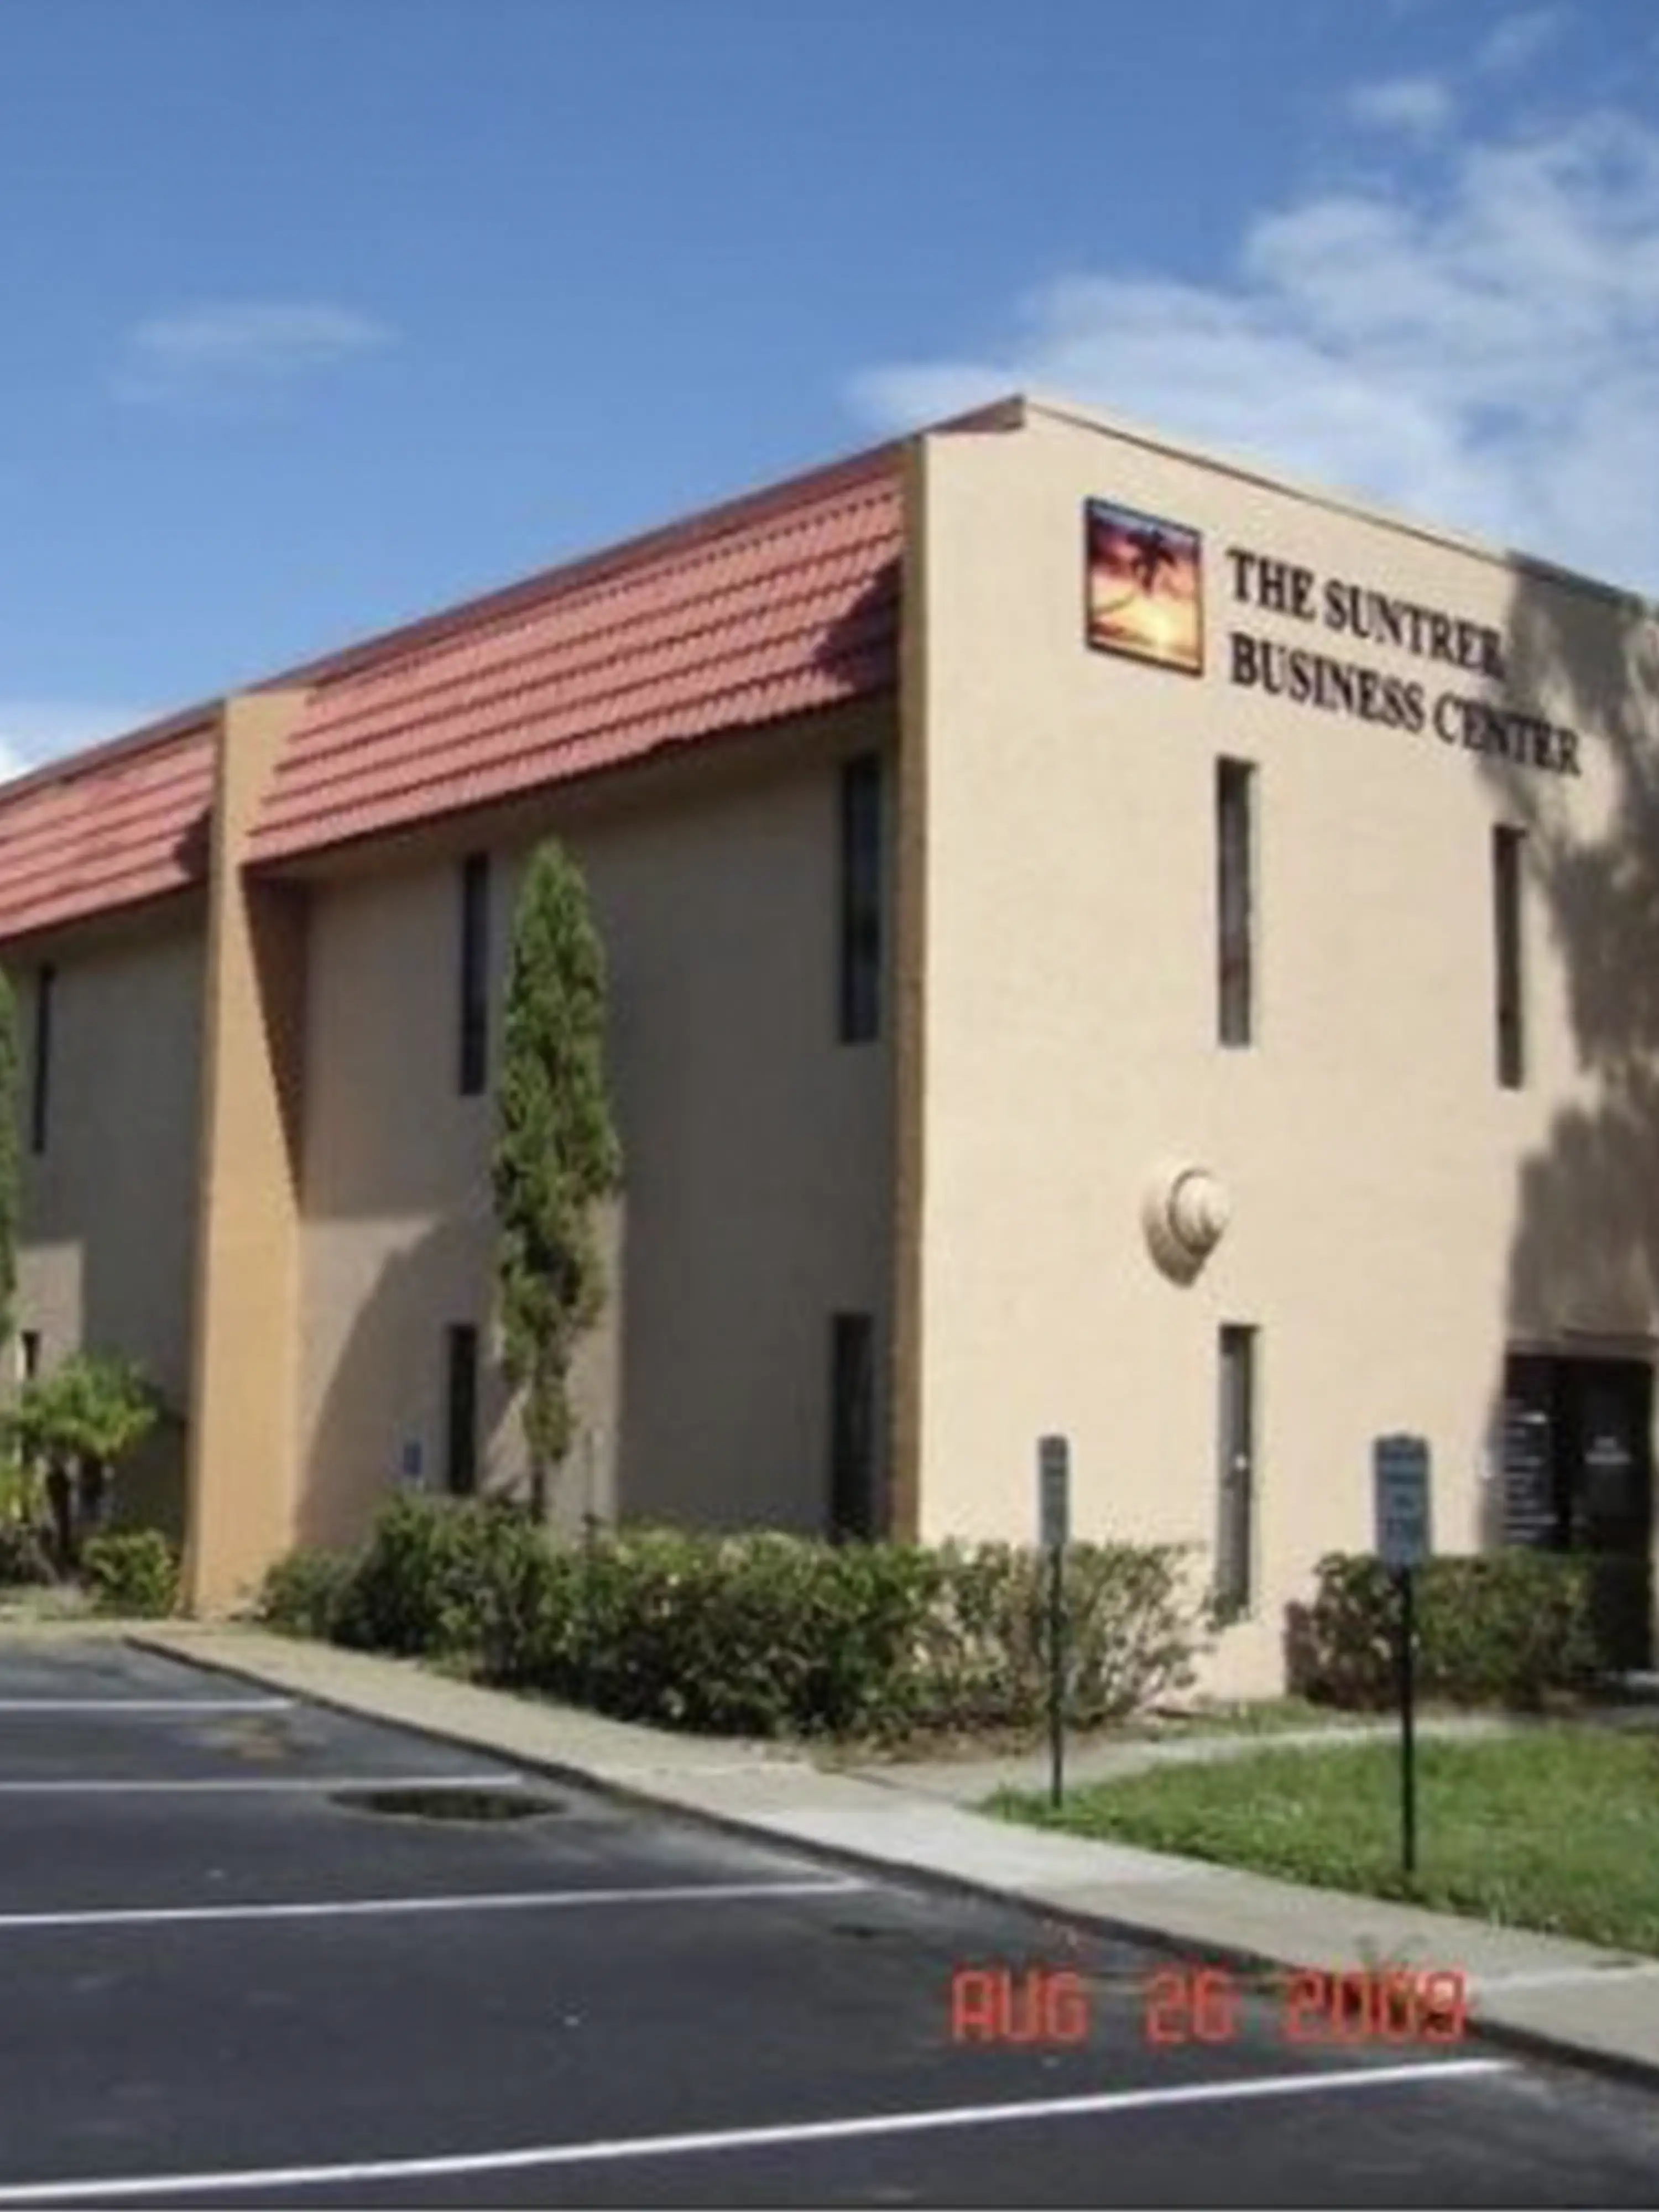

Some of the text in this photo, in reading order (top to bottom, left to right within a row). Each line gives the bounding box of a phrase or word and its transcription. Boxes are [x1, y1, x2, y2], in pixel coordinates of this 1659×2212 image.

[1226, 549, 1505, 680] THE SUNTREE
[1230, 632, 1581, 776] BUSINESS CENTER
